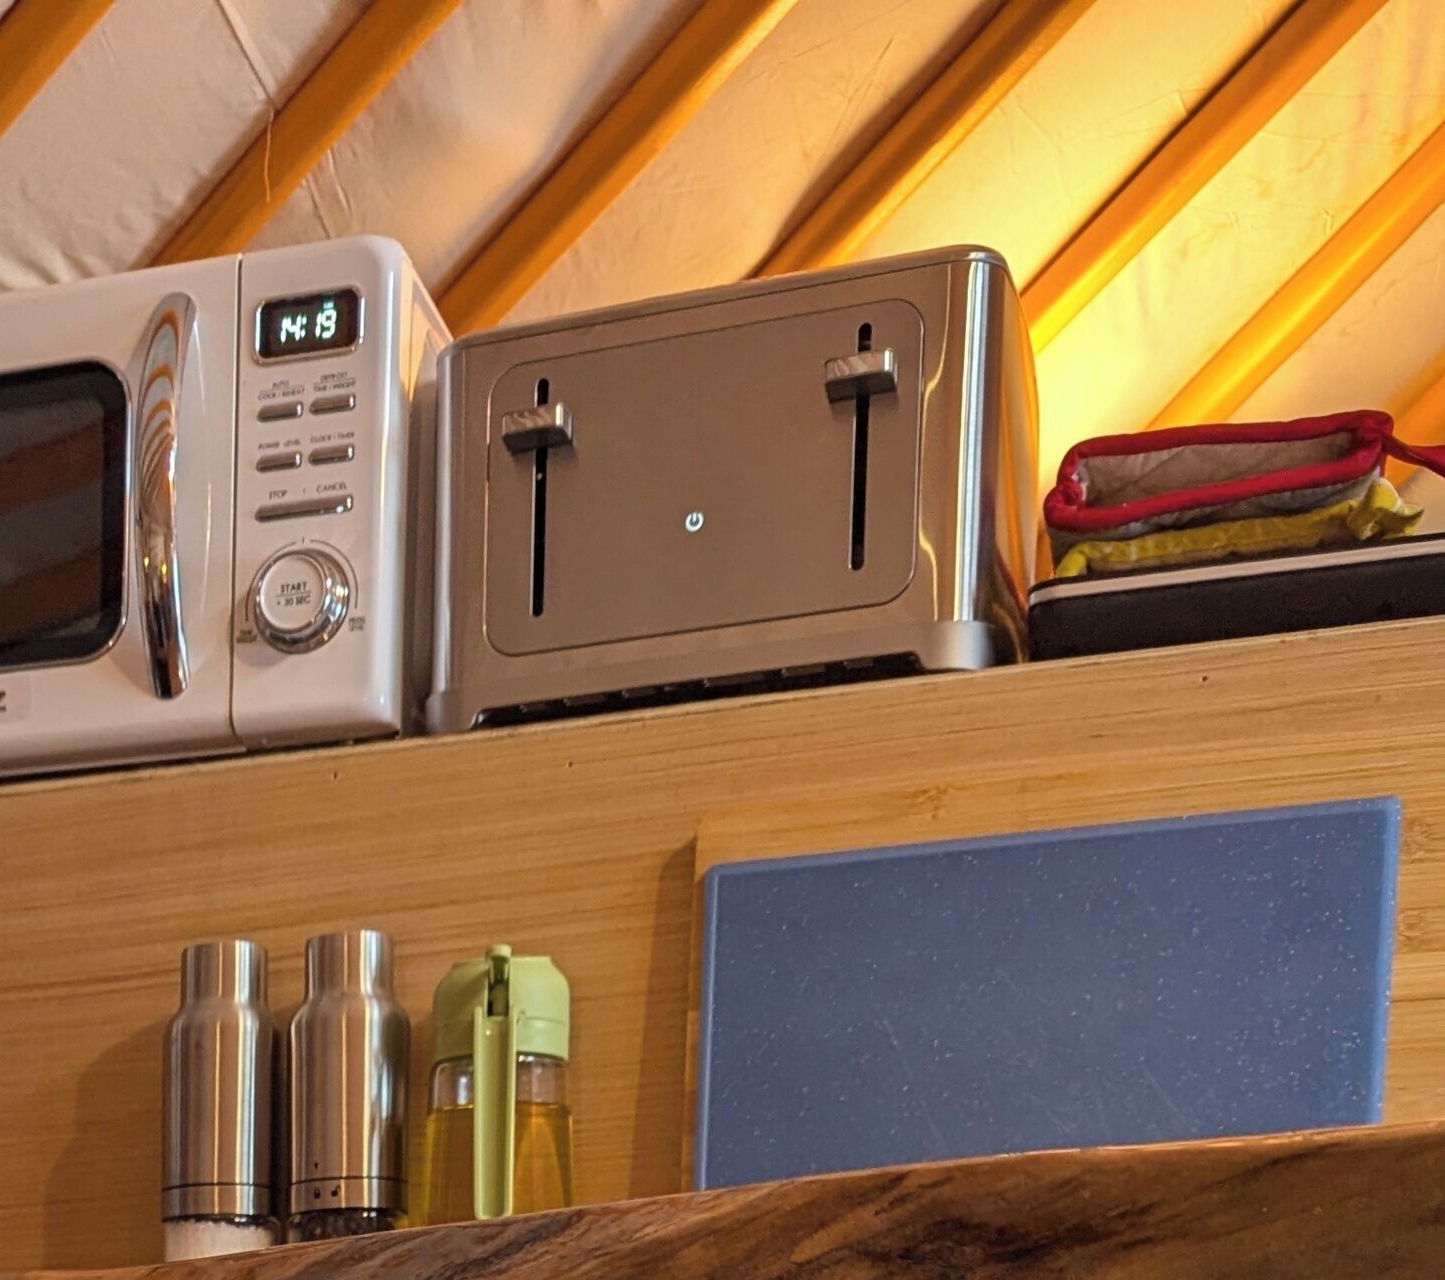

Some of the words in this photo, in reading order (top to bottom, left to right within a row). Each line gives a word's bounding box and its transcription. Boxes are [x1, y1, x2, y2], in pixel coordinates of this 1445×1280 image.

[279, 308, 338, 343] 14:19
[268, 488, 288, 500] STOP
[316, 481, 348, 494] CANCEL
[280, 581, 308, 593] START
[295, 594, 312, 605] SEC
